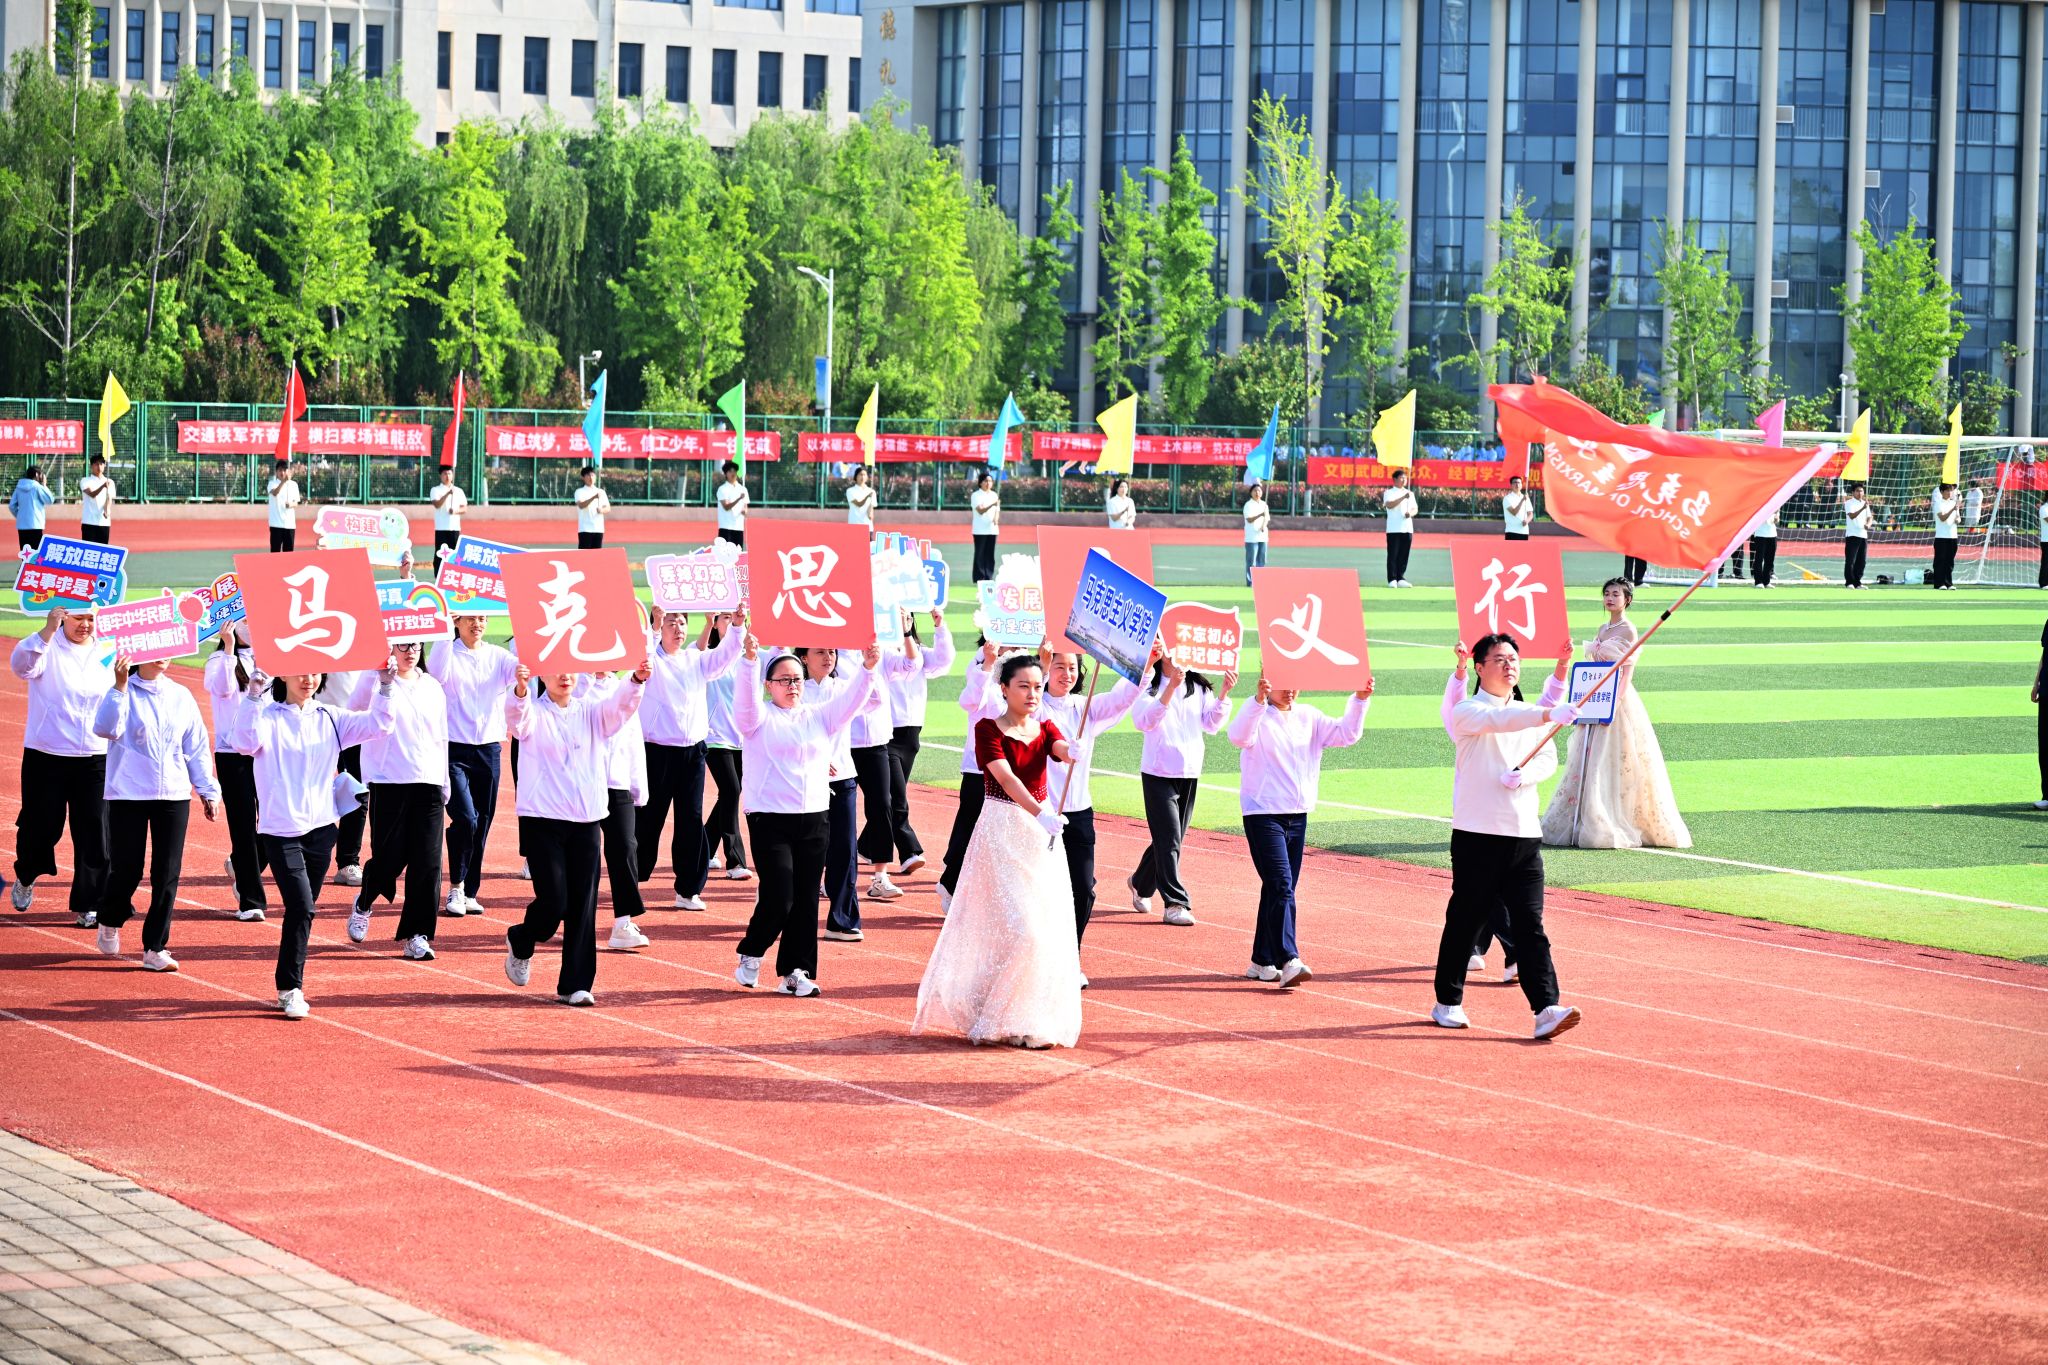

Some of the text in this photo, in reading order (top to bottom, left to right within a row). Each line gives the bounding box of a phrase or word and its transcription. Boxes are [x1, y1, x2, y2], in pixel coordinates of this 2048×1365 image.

[308, 427, 423, 446] 横扫赛场谁能敌
[345, 514, 378, 534] 构建
[45, 543, 120, 573] 解放思想
[21, 570, 90, 599] 实事求是
[771, 544, 852, 627] 思
[1001, 586, 1042, 611] 发展
[1474, 557, 1548, 641] 行
[97, 604, 173, 632] 铸牢中华民族
[274, 565, 357, 661] 马
[536, 560, 627, 663] 克
[1082, 573, 1153, 646] 马克思主义学院
[117, 625, 189, 655] 共同体意识
[1177, 624, 1235, 646] 不忘初心
[1269, 593, 1360, 666] 义
[1176, 645, 1235, 667] 牢记使命
